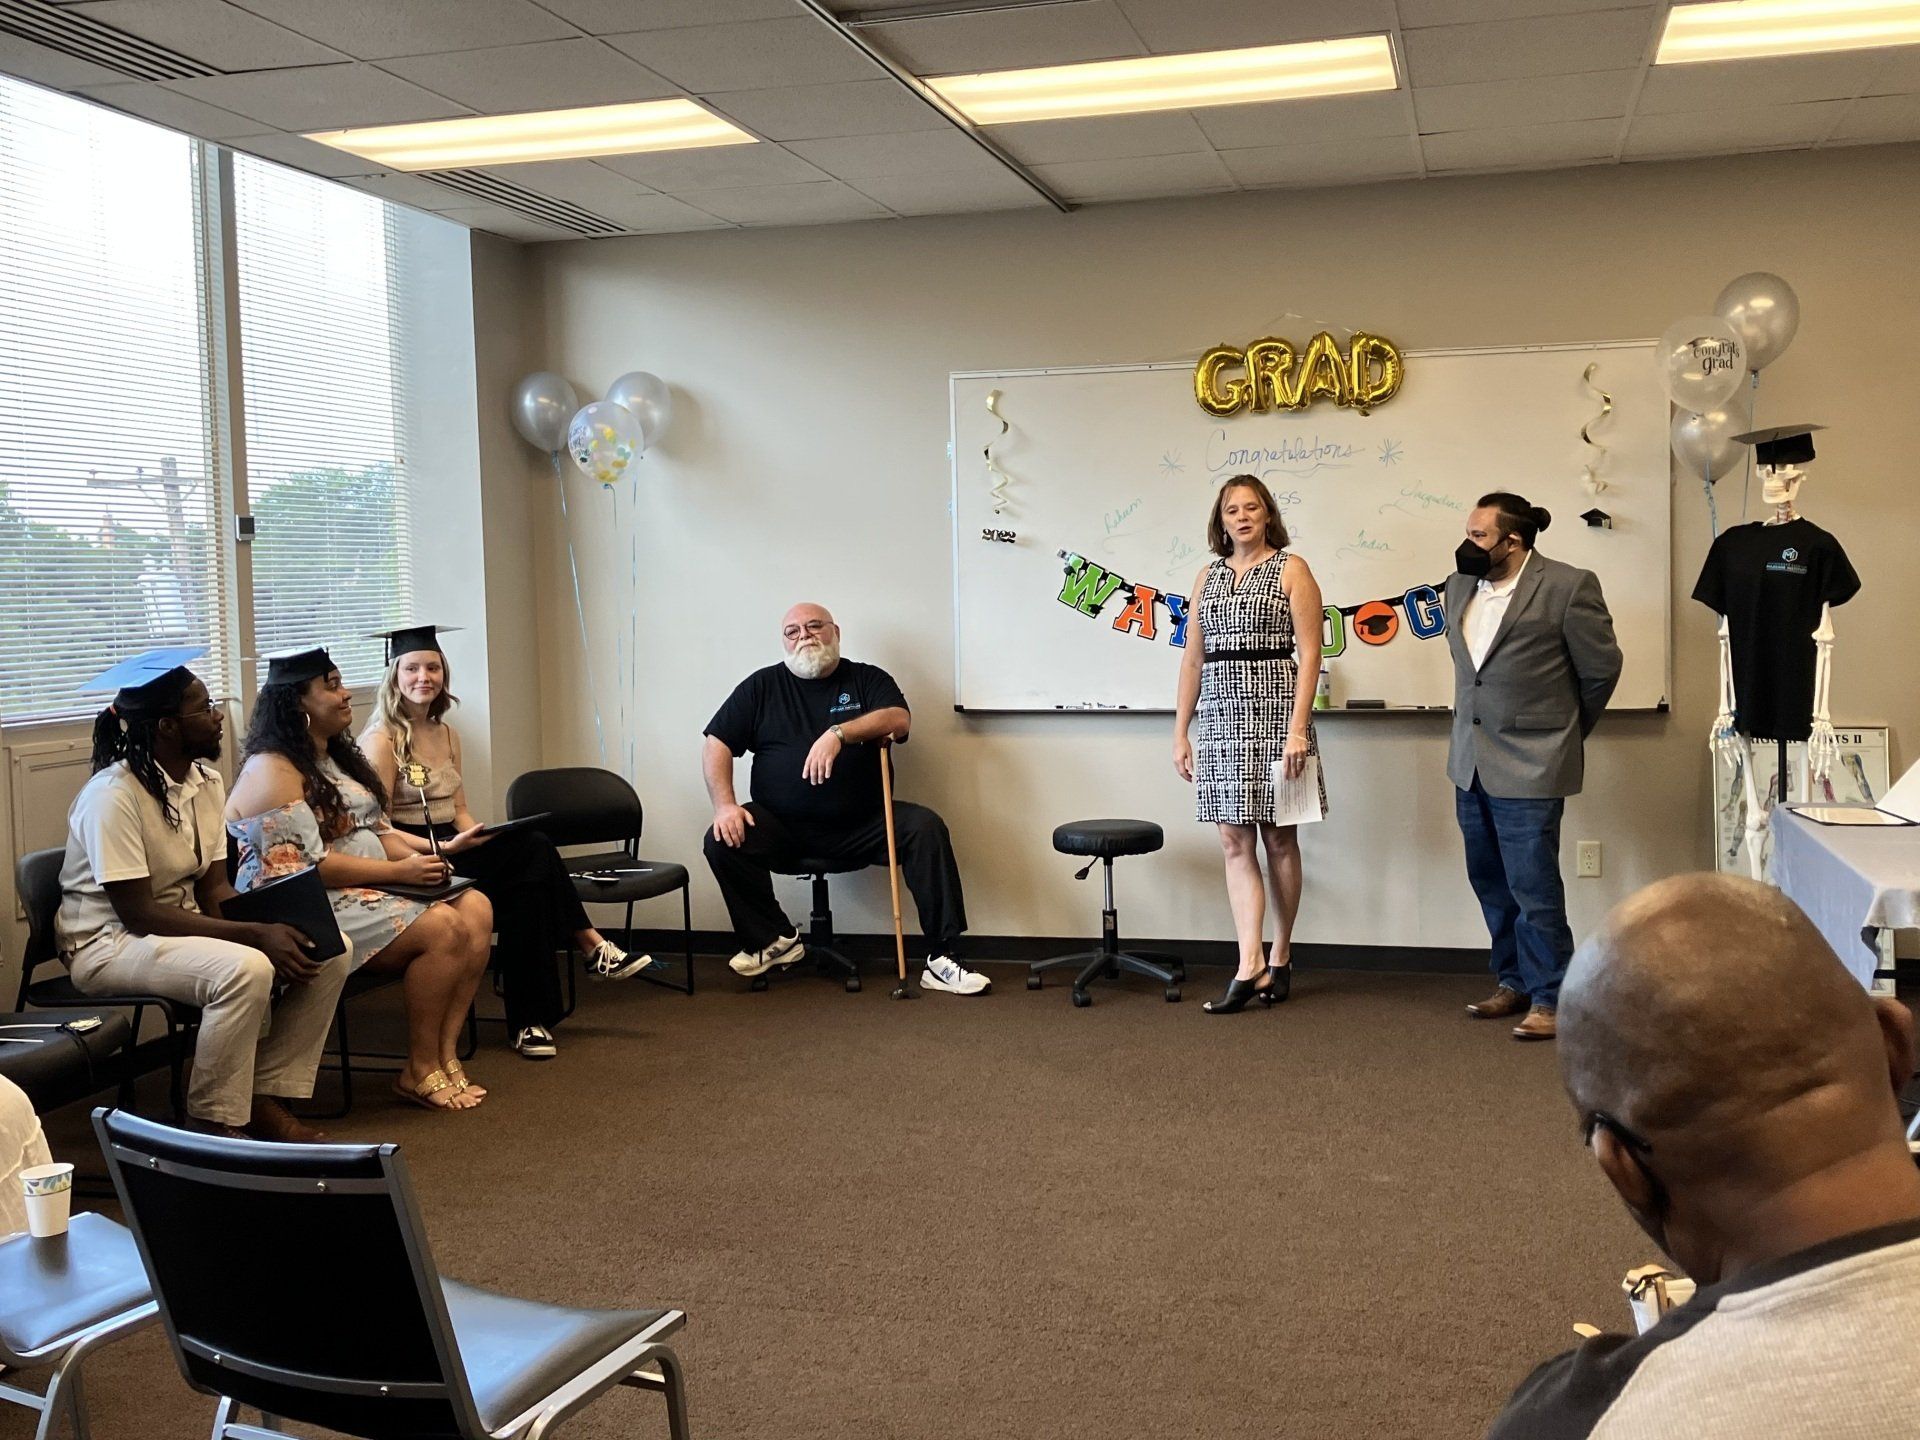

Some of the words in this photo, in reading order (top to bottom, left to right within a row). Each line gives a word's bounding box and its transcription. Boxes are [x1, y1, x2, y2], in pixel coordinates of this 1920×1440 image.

[1194, 331, 1404, 417] GRAD
[1702, 348, 1733, 376] grad
[1206, 429, 1365, 476] Congratulations
[982, 528, 1016, 543] 2022
[1057, 552, 1189, 648] WAY
[1403, 584, 1447, 640] G
